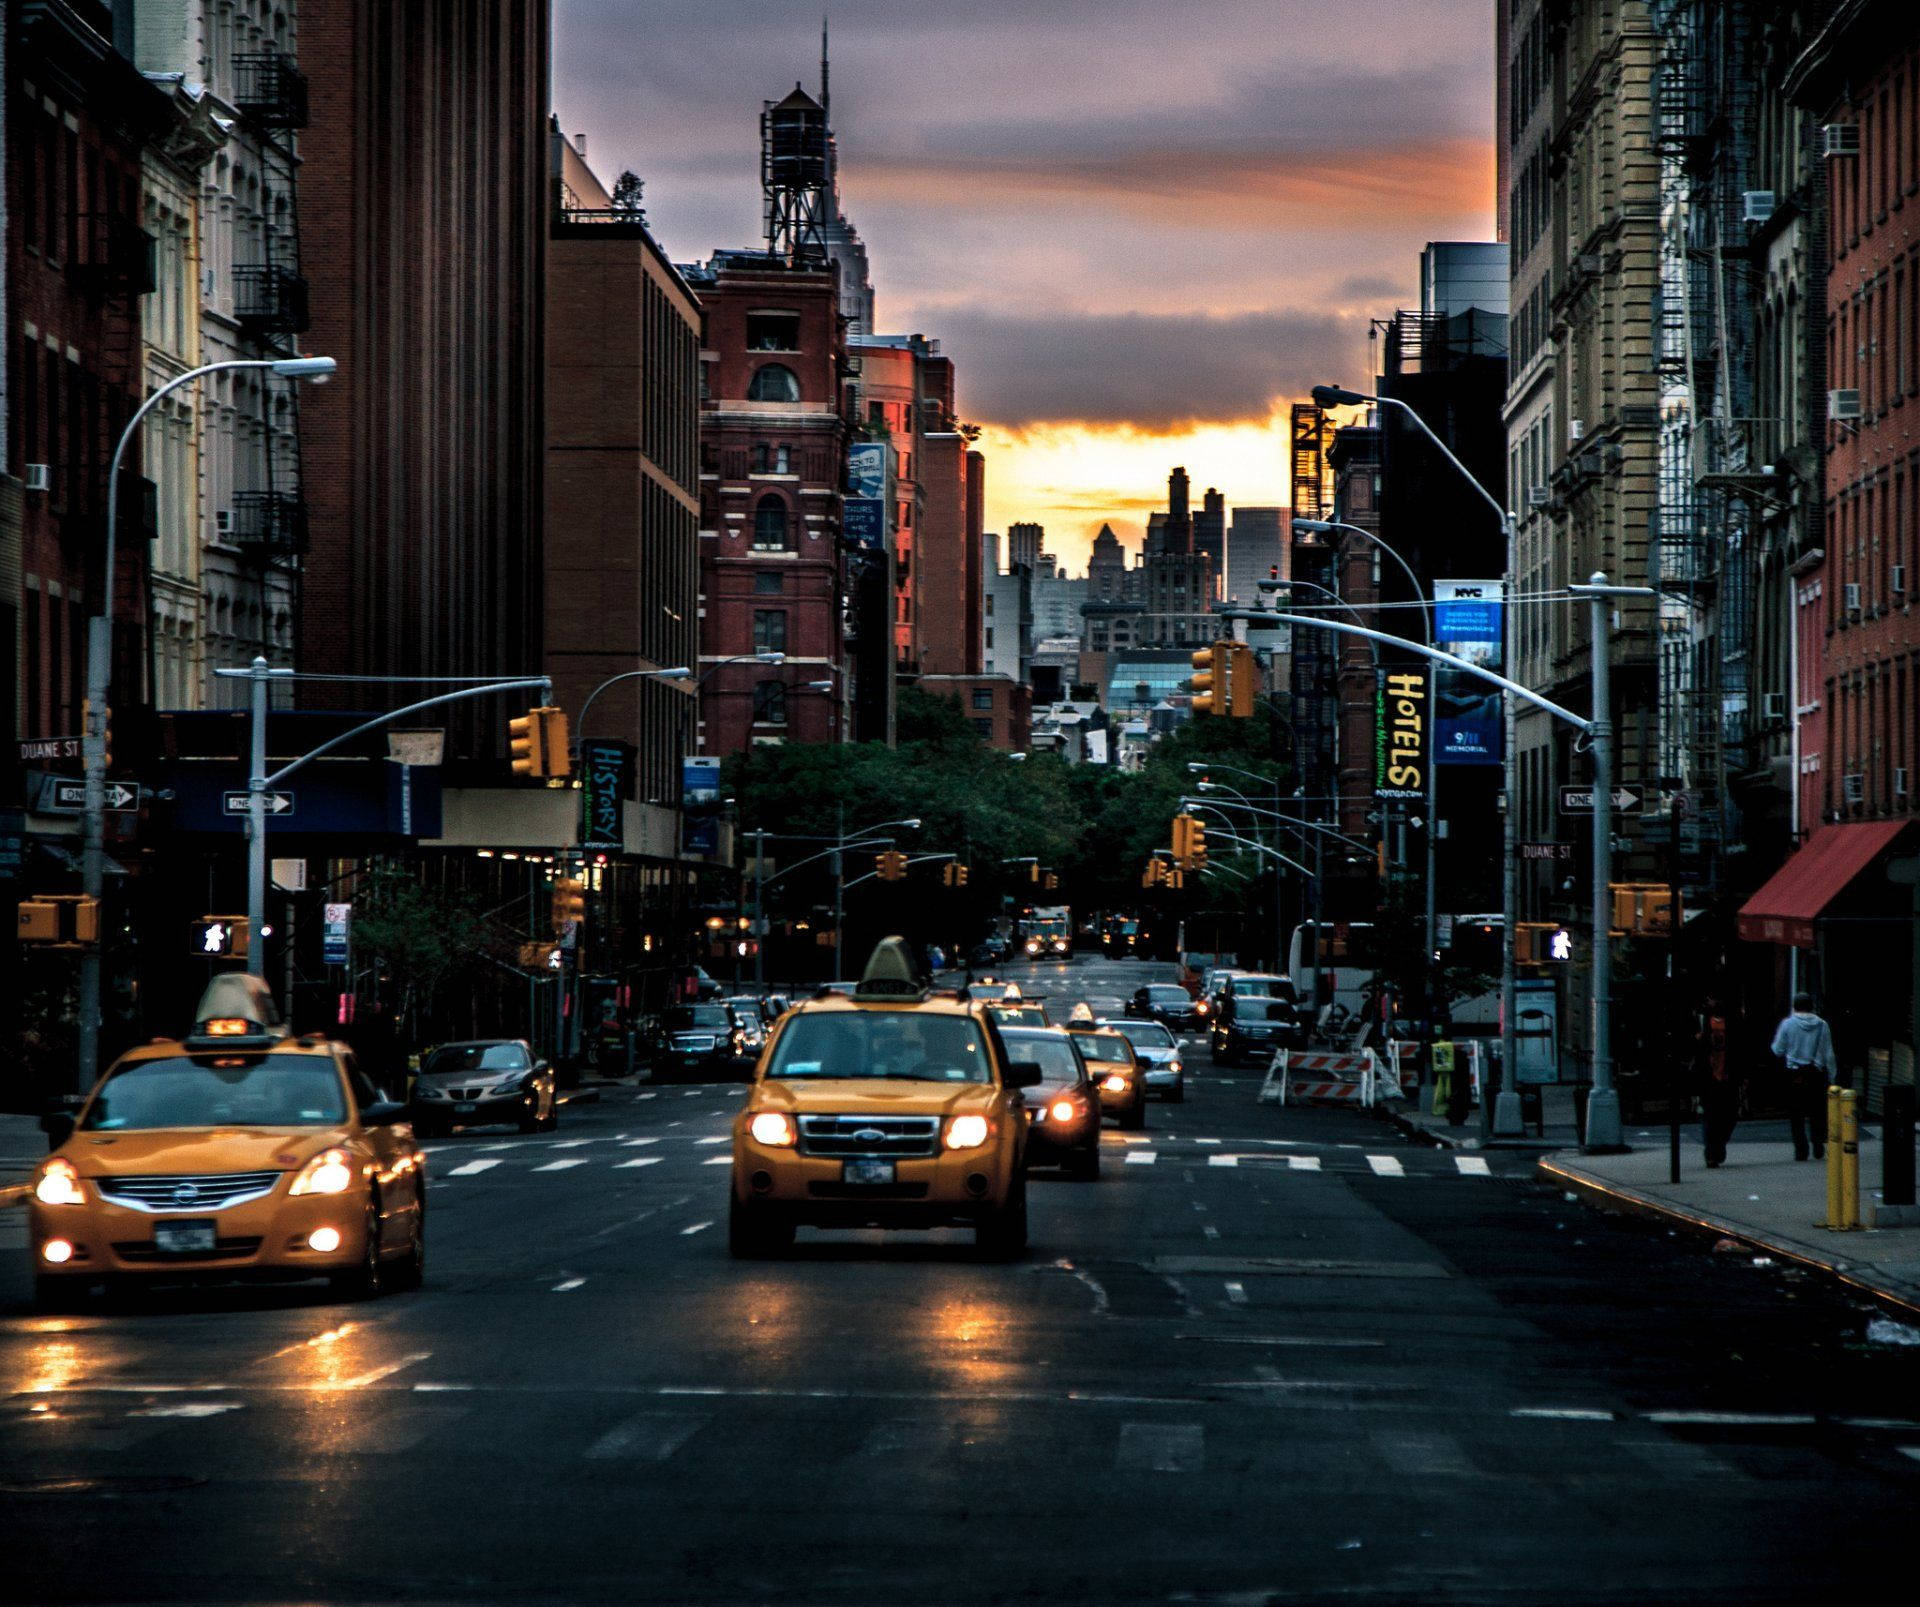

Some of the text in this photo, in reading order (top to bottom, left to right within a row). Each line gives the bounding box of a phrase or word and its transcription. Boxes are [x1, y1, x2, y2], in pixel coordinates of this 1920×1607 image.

[1455, 588, 1482, 597] NYC
[21, 741, 79, 759] DUANE ST
[1569, 794, 1591, 805] ONE
[1523, 845, 1571, 859] DUANE ST
